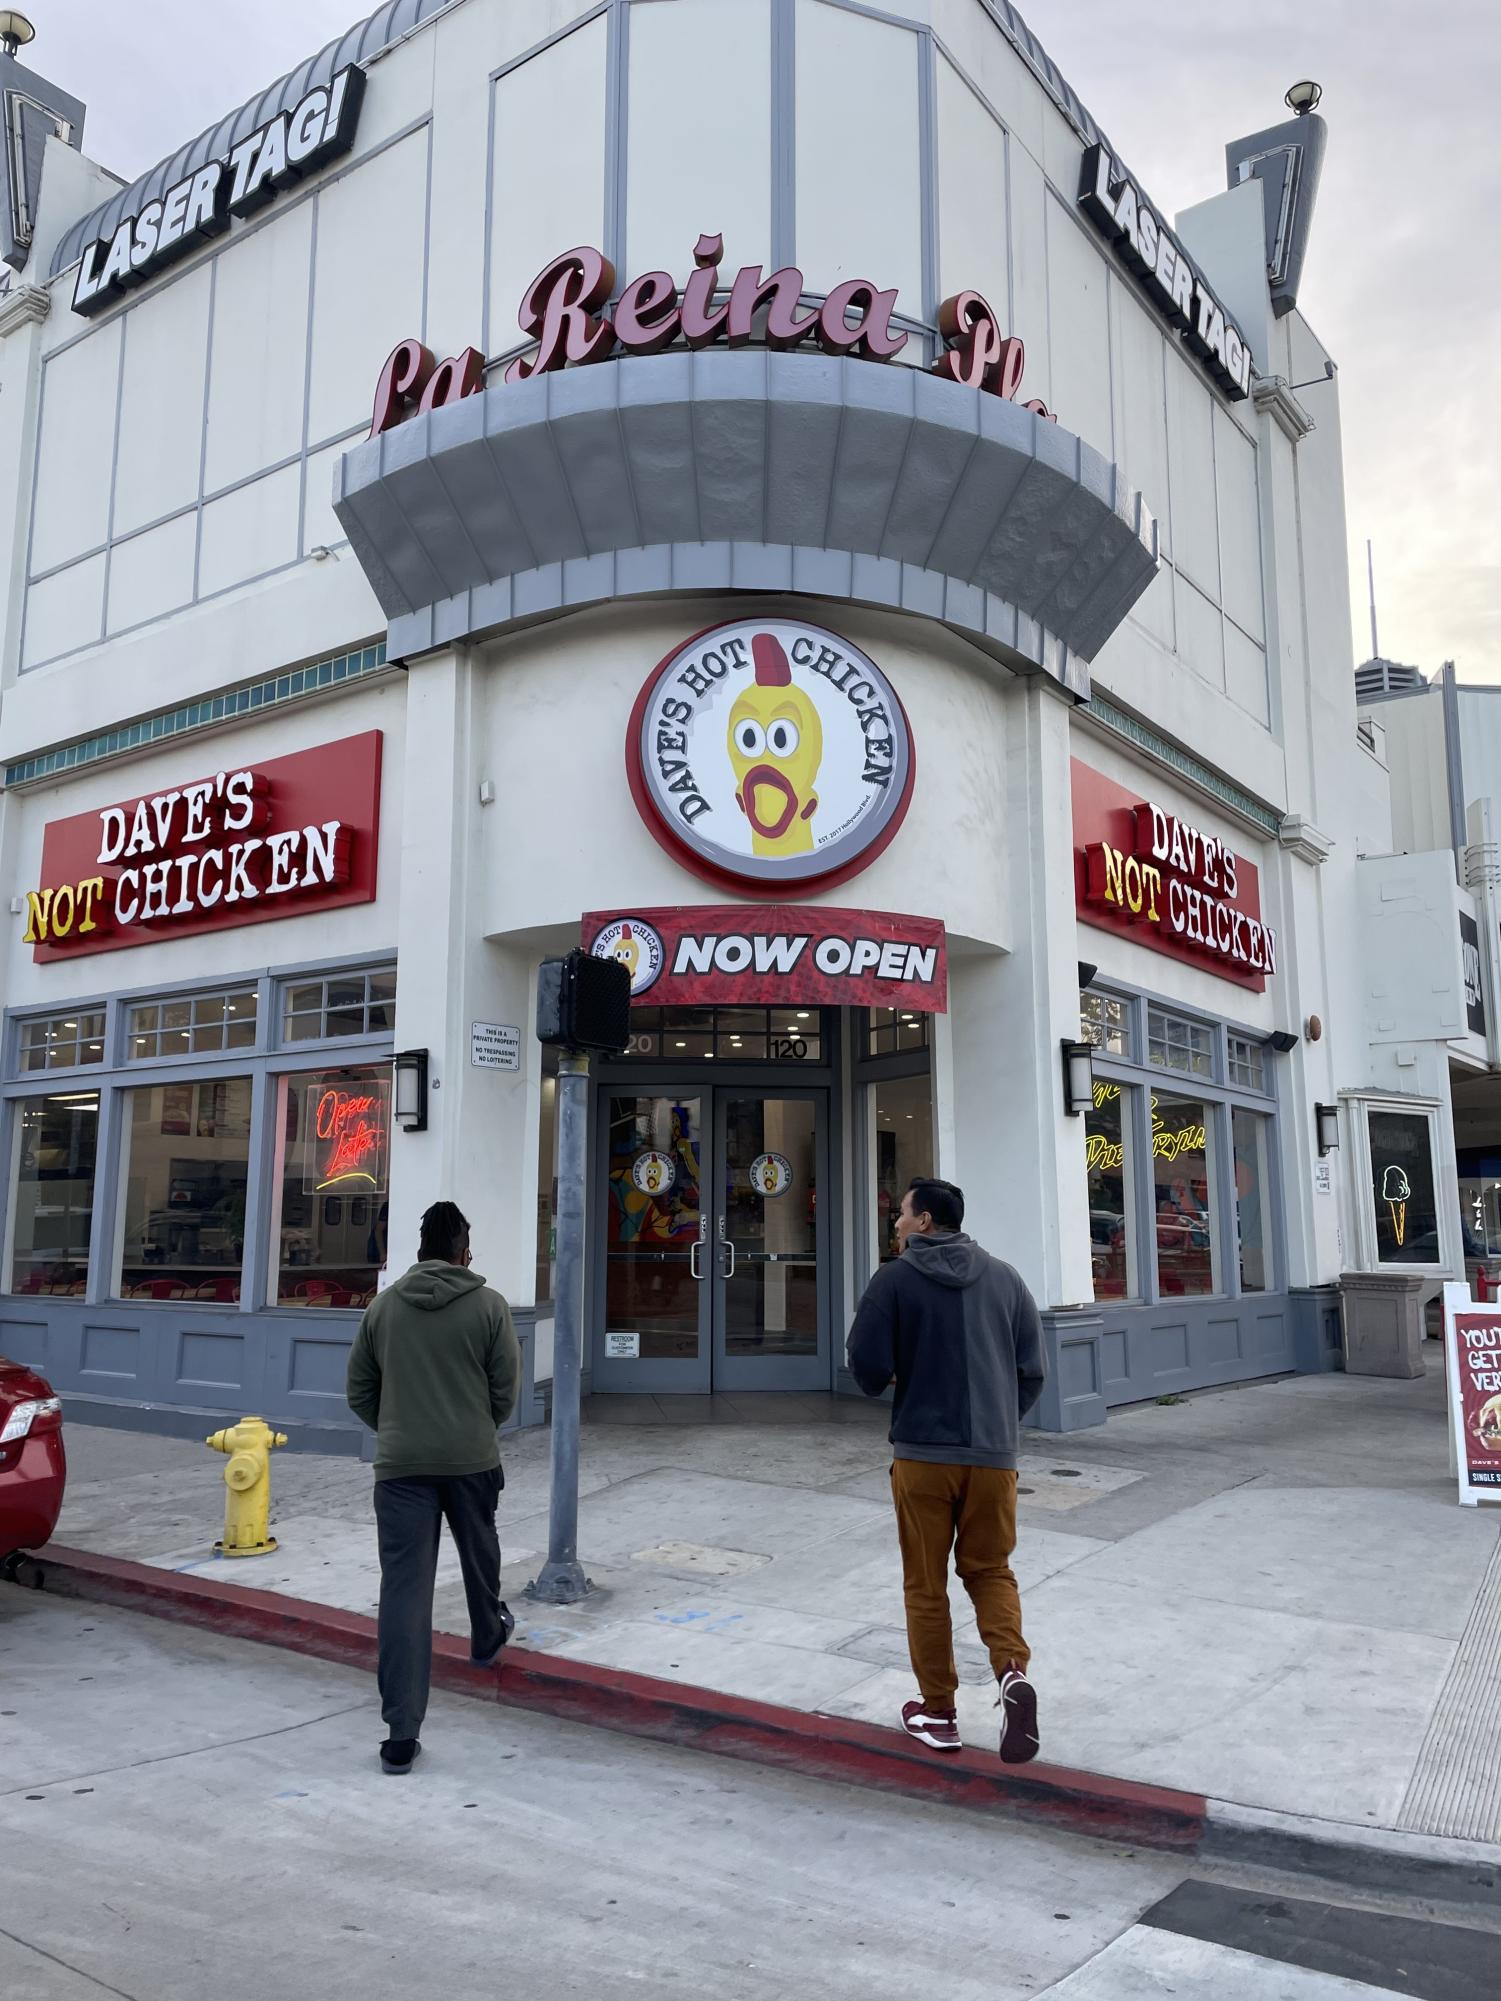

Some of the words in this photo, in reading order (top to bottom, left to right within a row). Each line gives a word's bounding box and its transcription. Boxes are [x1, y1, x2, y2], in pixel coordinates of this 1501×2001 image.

[74, 161, 222, 306] LASER
[229, 69, 349, 205] TAG!
[1096, 148, 1194, 323] LASER
[1195, 280, 1252, 394] TAG!
[504, 232, 908, 383] Reina
[941, 289, 1058, 424] Pl
[677, 637, 749, 699] HOT
[791, 637, 895, 790] CHICKEN
[656, 696, 713, 825] DAVE'S
[97, 771, 254, 864] DAVE'S
[829, 827, 842, 838] 2017
[841, 806, 864, 830] Hollywood
[1149, 802, 1239, 899] DAVE'S
[22, 875, 104, 943] NOT
[114, 820, 341, 925] CHICKEN
[1102, 841, 1162, 922] NOT
[1169, 878, 1278, 975] CHICKEN
[602, 925, 621, 944] HOT
[632, 924, 659, 970] CHICKEN
[673, 934, 809, 974] NOW
[815, 937, 937, 983] OPEN
[473, 1035, 493, 1043] PRIVATE
[494, 1037, 518, 1046] PROPERTY
[484, 1047, 515, 1057] TRESPASSING
[487, 1056, 512, 1065] LOITERING
[626, 1034, 653, 1054] 20
[770, 1038, 808, 1059] 120
[316, 1090, 375, 1139] Open
[1472, 1472, 1496, 1482] SINGLE
